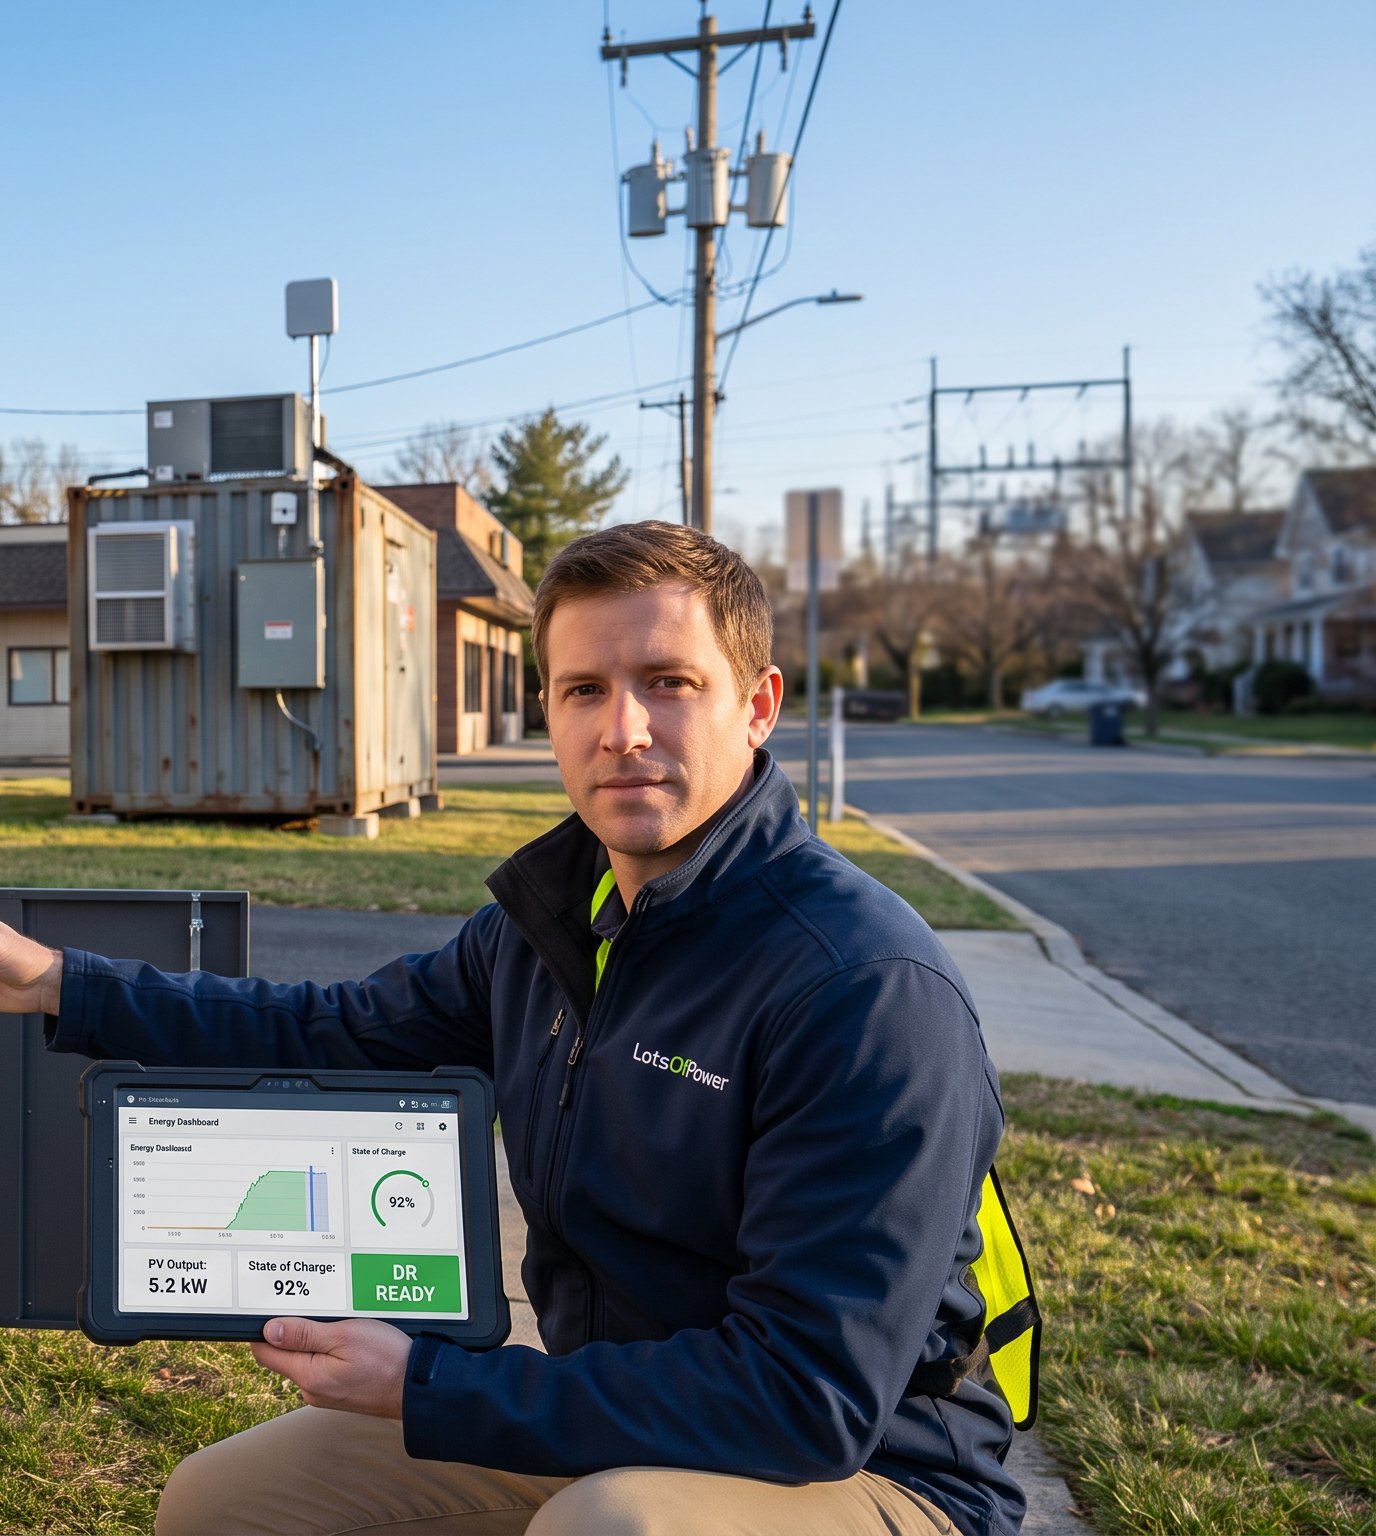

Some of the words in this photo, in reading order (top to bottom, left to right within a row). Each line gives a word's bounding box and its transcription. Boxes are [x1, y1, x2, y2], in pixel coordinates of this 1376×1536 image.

[633, 1042, 729, 1091] LotsOfPower
[148, 1117, 176, 1128] Energy
[177, 1118, 219, 1126] Dashboard
[130, 1143, 155, 1153] Energy
[352, 1147, 371, 1155] State
[372, 1147, 380, 1155] of
[381, 1148, 407, 1158] Charge
[389, 1196, 415, 1208] 92%
[148, 1258, 165, 1269] PV
[167, 1259, 207, 1273] Output:
[248, 1260, 277, 1272] State
[280, 1260, 292, 1272] of
[294, 1261, 336, 1275] Charge:
[393, 1264, 418, 1281] DR
[148, 1277, 176, 1294] 5.2
[181, 1277, 208, 1294] kW
[273, 1279, 310, 1296] 92%
[376, 1284, 436, 1302] READY
